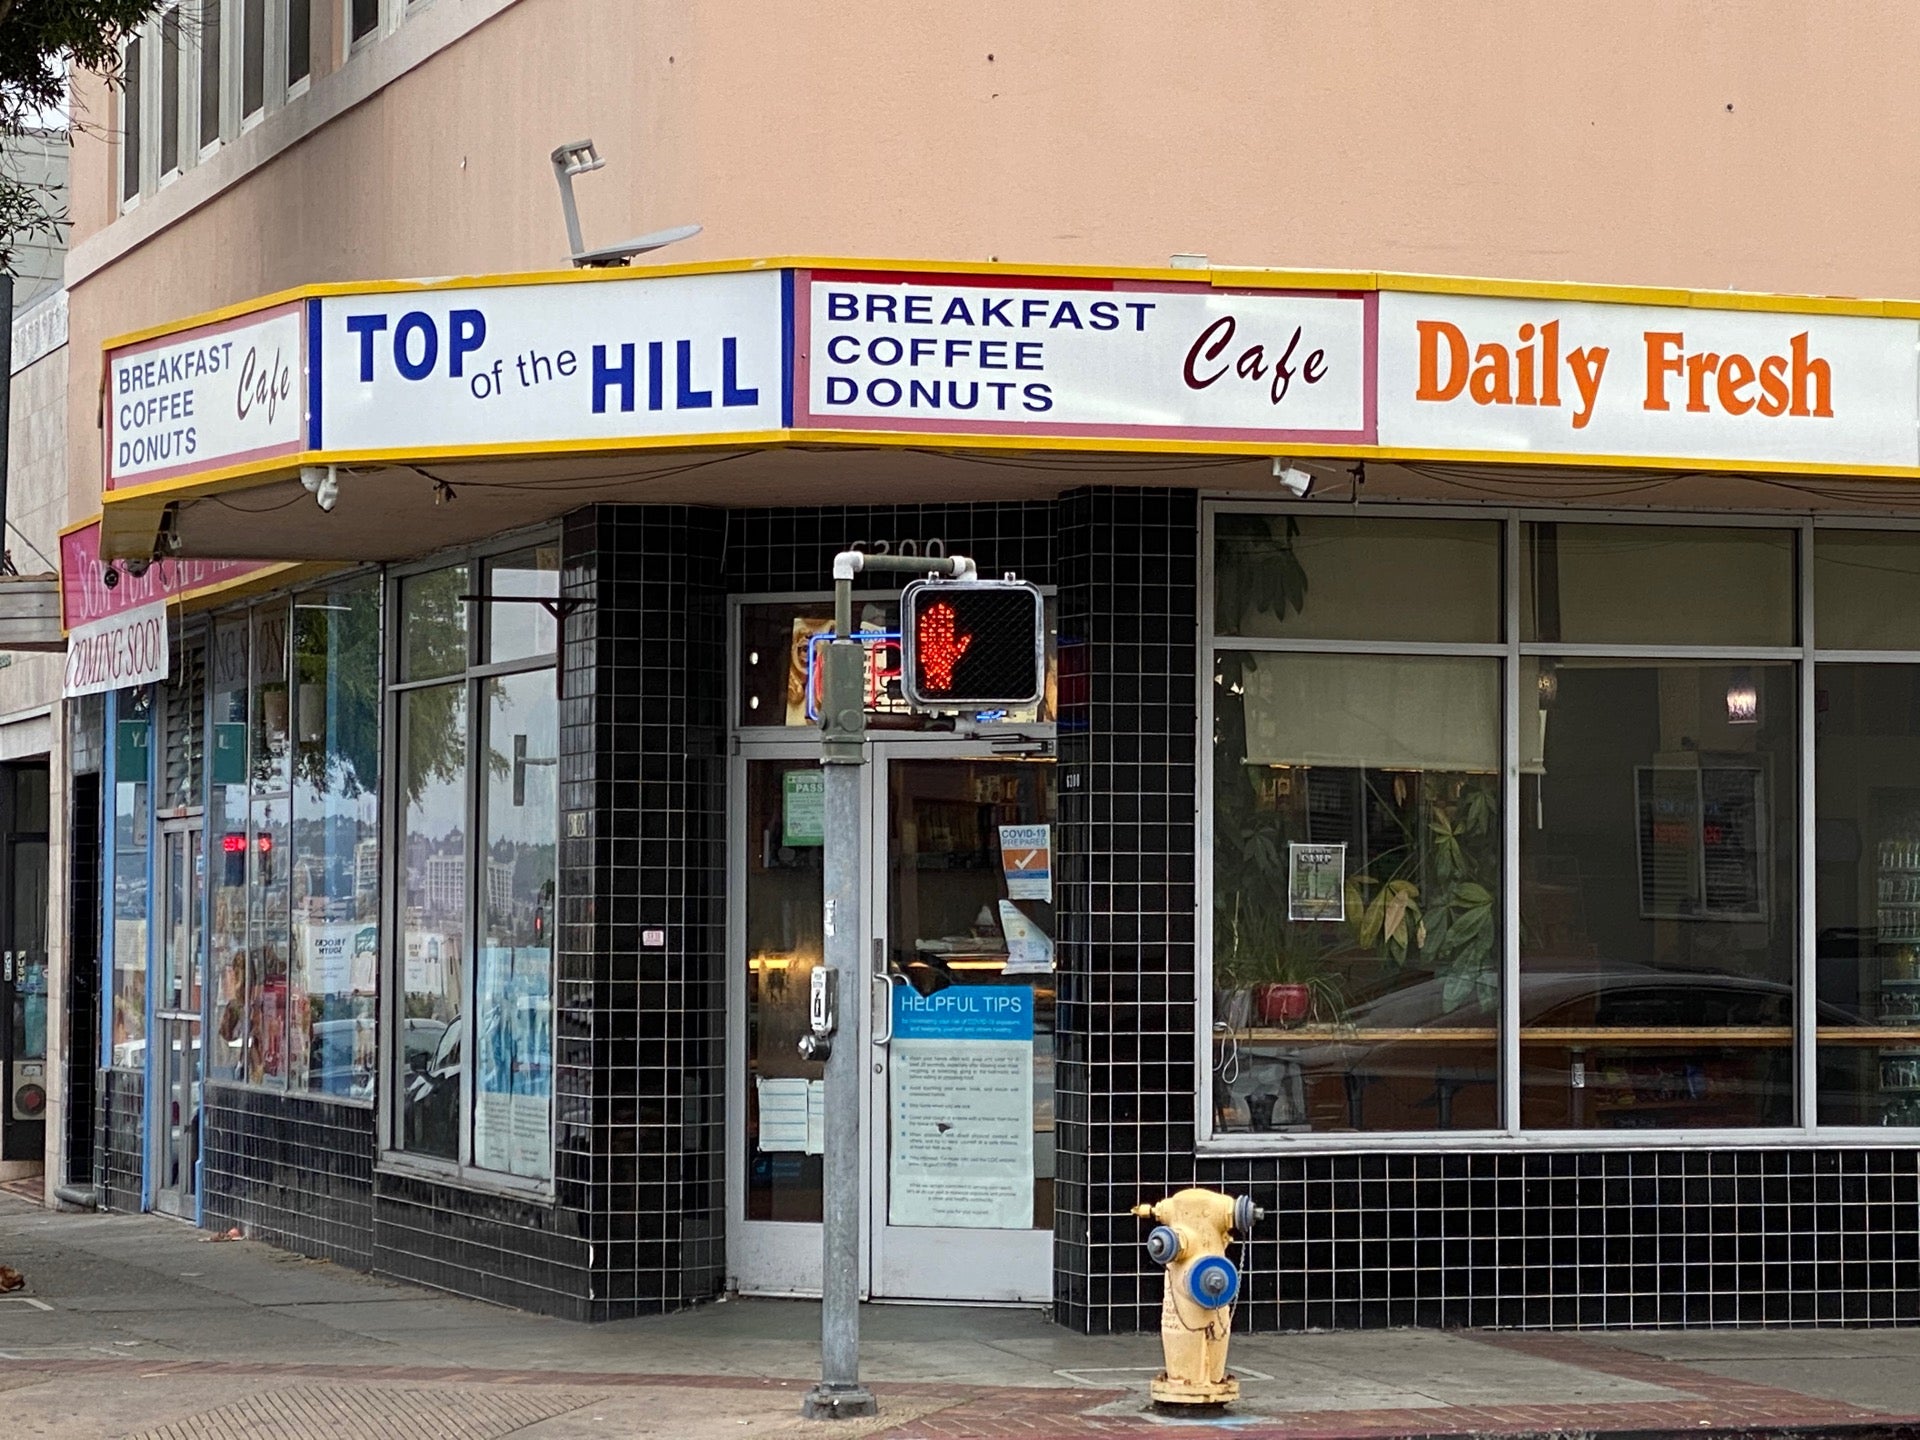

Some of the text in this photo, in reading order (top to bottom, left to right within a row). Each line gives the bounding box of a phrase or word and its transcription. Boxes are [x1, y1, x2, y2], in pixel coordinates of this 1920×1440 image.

[828, 292, 1156, 331] BREAKFAST
[346, 309, 486, 383] TOP
[827, 335, 1044, 371] COFFEE
[1183, 316, 1328, 405] Cafe
[119, 342, 233, 395] BREAKFAST
[237, 346, 290, 425] Cafe
[470, 350, 577, 399] of the
[592, 337, 759, 414] HILL
[1416, 319, 1834, 429] Daily Fresh
[120, 390, 194, 431] COFFEE
[826, 376, 1053, 412] DONUTS
[119, 427, 196, 468] DONUTS
[64, 629, 122, 689] COMING
[126, 616, 163, 677] SOON
[796, 783, 824, 793] PASS
[1002, 829, 1046, 839] COVID-19
[1002, 838, 1046, 846] PREPARED
[902, 996, 1022, 1013] HELPFUL TIPS
